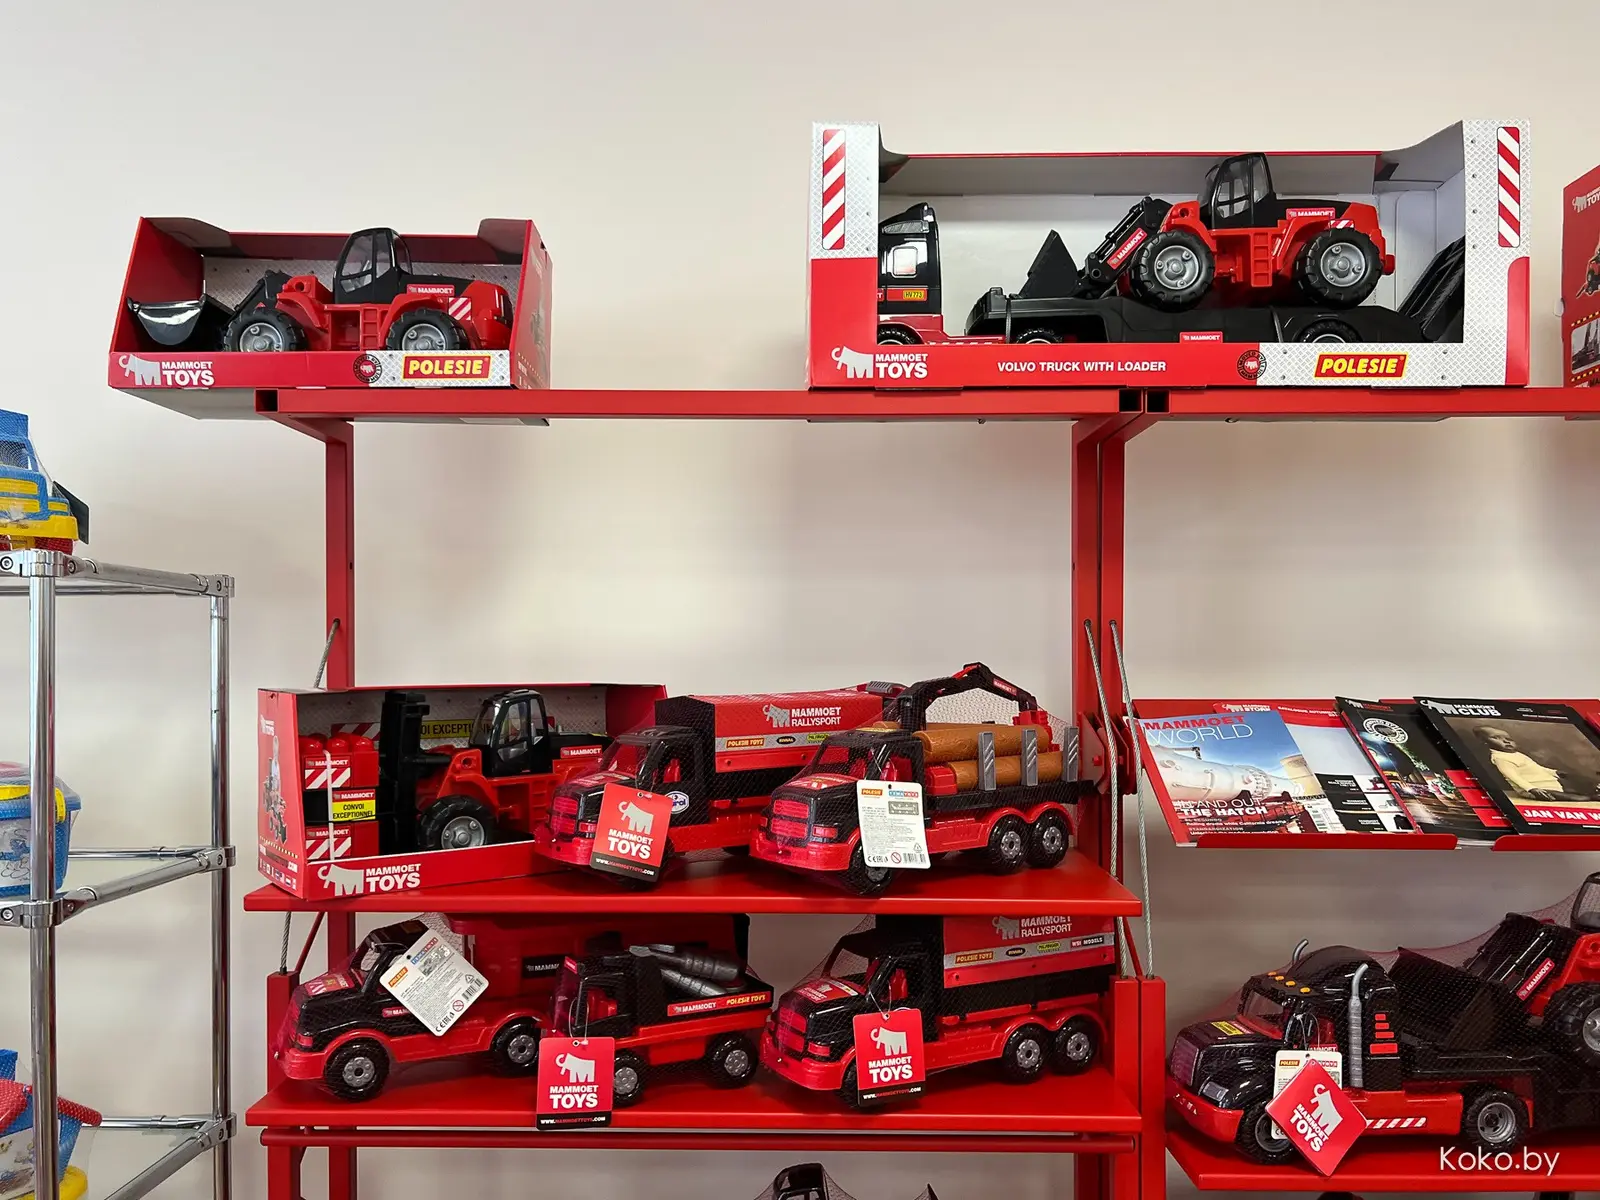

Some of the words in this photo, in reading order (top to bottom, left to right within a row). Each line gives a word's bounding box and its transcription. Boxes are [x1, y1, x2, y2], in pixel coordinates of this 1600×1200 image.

[1117, 230, 1145, 260] MAMMOET
[876, 353, 928, 362] MAMMOET
[162, 361, 213, 370] MAMMOET
[408, 359, 483, 375] POLESIE
[876, 362, 928, 379] TOYS
[997, 361, 1036, 372] VOLVO
[1039, 361, 1081, 372] TRUCK
[1084, 361, 1114, 371] WITH
[1117, 361, 1167, 371] LOADER
[1320, 358, 1399, 374] POLESIE
[162, 370, 215, 386] TOYS
[791, 706, 842, 719] MAMMOET
[1458, 707, 1502, 717] CLUB
[791, 715, 842, 727] RALLYSPORT
[1146, 715, 1246, 730] MAMMOET
[1148, 723, 1254, 745] WORLD
[750, 738, 764, 746] TOYS
[570, 748, 602, 756] MAMMOET
[341, 791, 374, 800] MAMMOET
[1197, 799, 1229, 809] AND
[1230, 796, 1264, 809] OUT
[343, 803, 365, 811] CONVOI
[1181, 807, 1213, 817] THE
[1215, 805, 1269, 816] HATCH
[1523, 809, 1553, 819] JAN
[1554, 810, 1588, 821] VAN
[608, 827, 654, 846] MAMMOET
[607, 836, 652, 859] TOYS
[365, 863, 421, 877] MAMMOET
[365, 872, 421, 893] TOYS
[1021, 922, 1073, 938] RALLYSPORT
[957, 955, 978, 964] POLESIE
[978, 953, 993, 961] TOYS
[1526, 961, 1553, 991] MAMMOET
[681, 1002, 717, 1012] MAMMOET
[726, 996, 750, 1006] POLESIE
[751, 994, 766, 1002] TOYS
[868, 1056, 912, 1068] MAMMOET
[869, 1064, 913, 1084] TOYS
[549, 1085, 599, 1094] MAMMOET
[549, 1093, 598, 1109] TOYS
[1296, 1103, 1330, 1142] MAMMOET
[1290, 1108, 1324, 1152] TOYS
